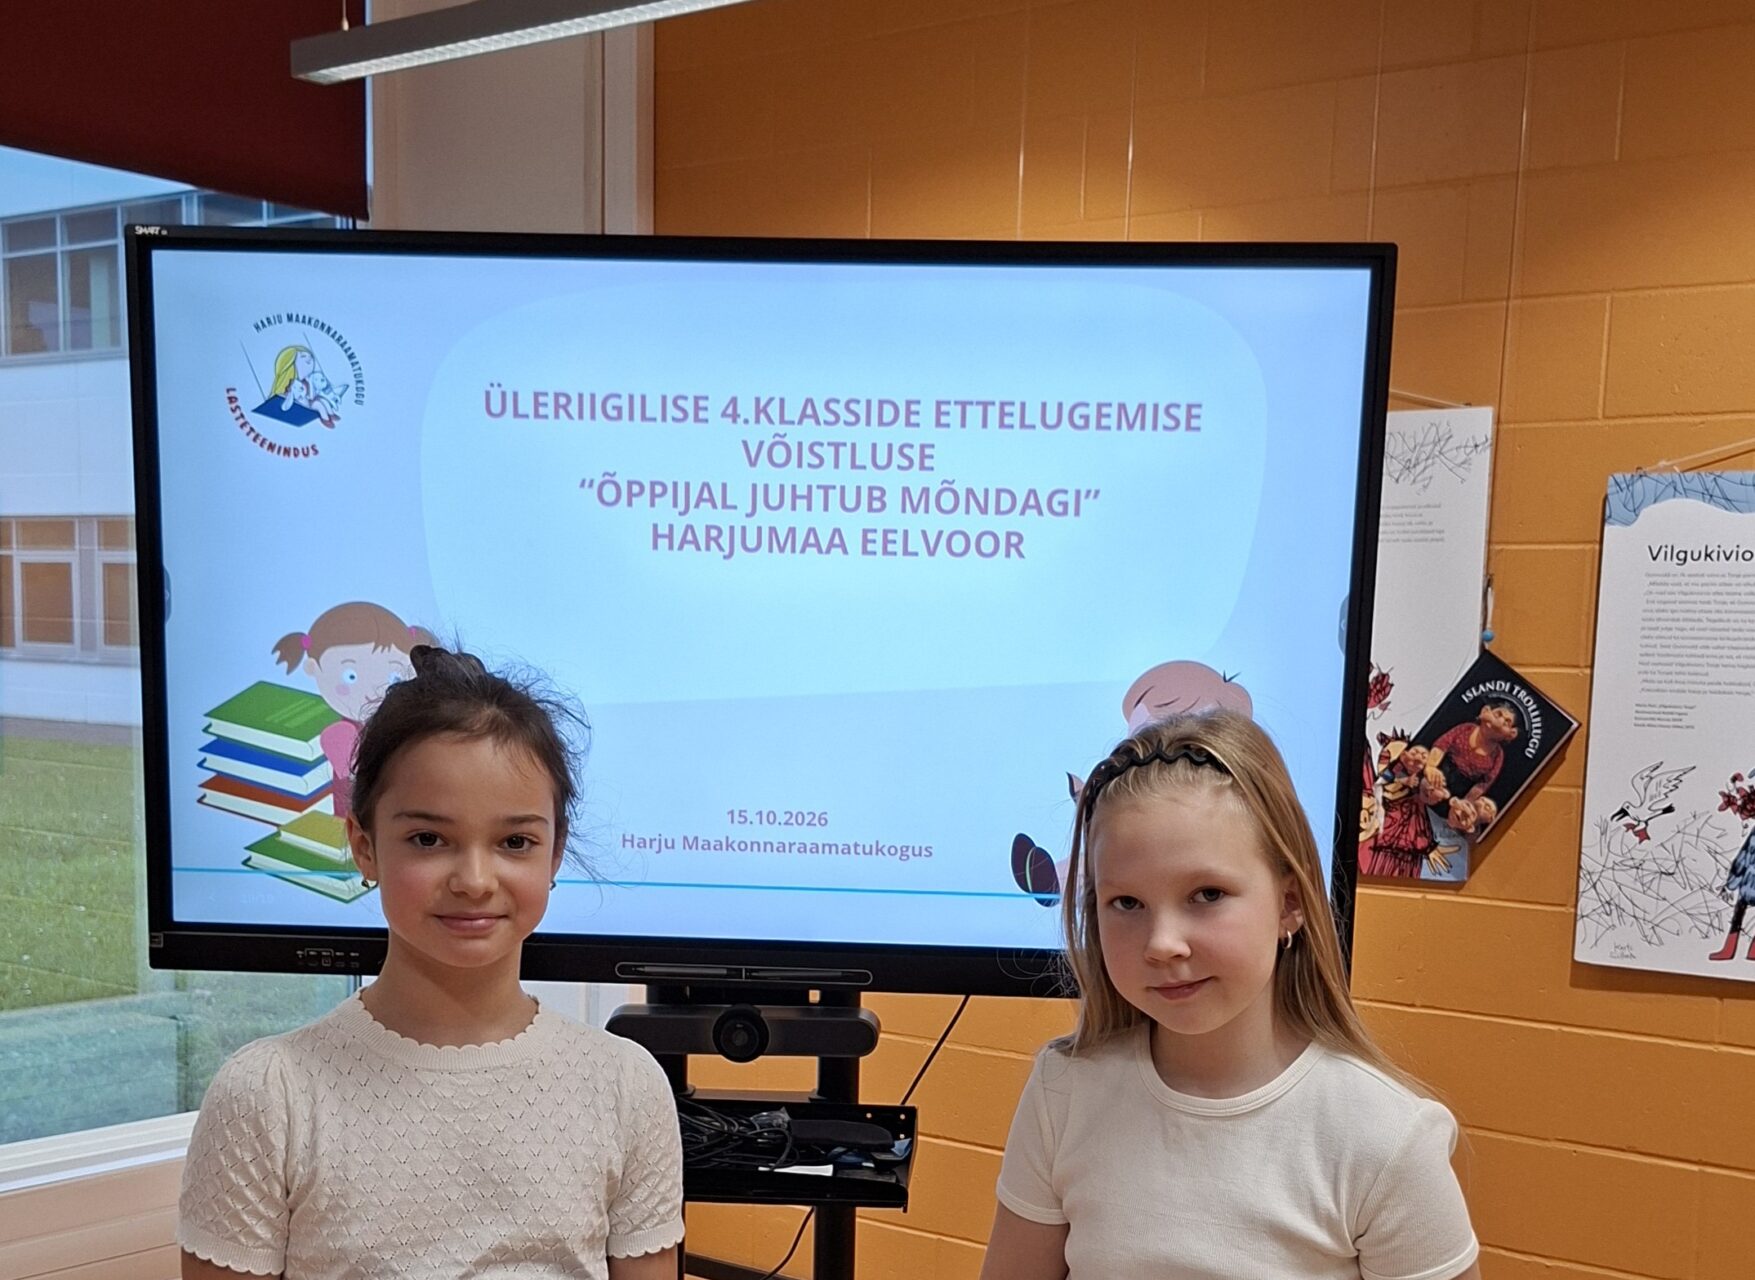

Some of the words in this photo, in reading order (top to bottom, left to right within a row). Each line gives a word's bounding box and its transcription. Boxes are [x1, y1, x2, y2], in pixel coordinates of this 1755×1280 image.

[253, 313, 283, 333] HARJU
[286, 312, 366, 407] MAAKONNARAAMATUKOGU
[225, 386, 320, 459] LASTETEENINDUS
[484, 382, 710, 424] ÜLERIIGILISE
[720, 395, 922, 427] 4.KLASSIDE
[934, 399, 1203, 432] ETTELUGEMISE
[741, 432, 936, 473] VÕISTLUSE
[745, 482, 888, 519] JUHTUB
[651, 522, 849, 561] HARJUMAA
[861, 527, 1026, 560] EELVOOR
[1647, 543, 1755, 567] Vilgukivio
[1461, 680, 1511, 704] ISLANDI
[1511, 684, 1542, 760] TROLLILUGU
[726, 808, 830, 828] 15.10.2026
[621, 832, 676, 855] Harju
[682, 834, 934, 862] Maakonnaraamatukogus
